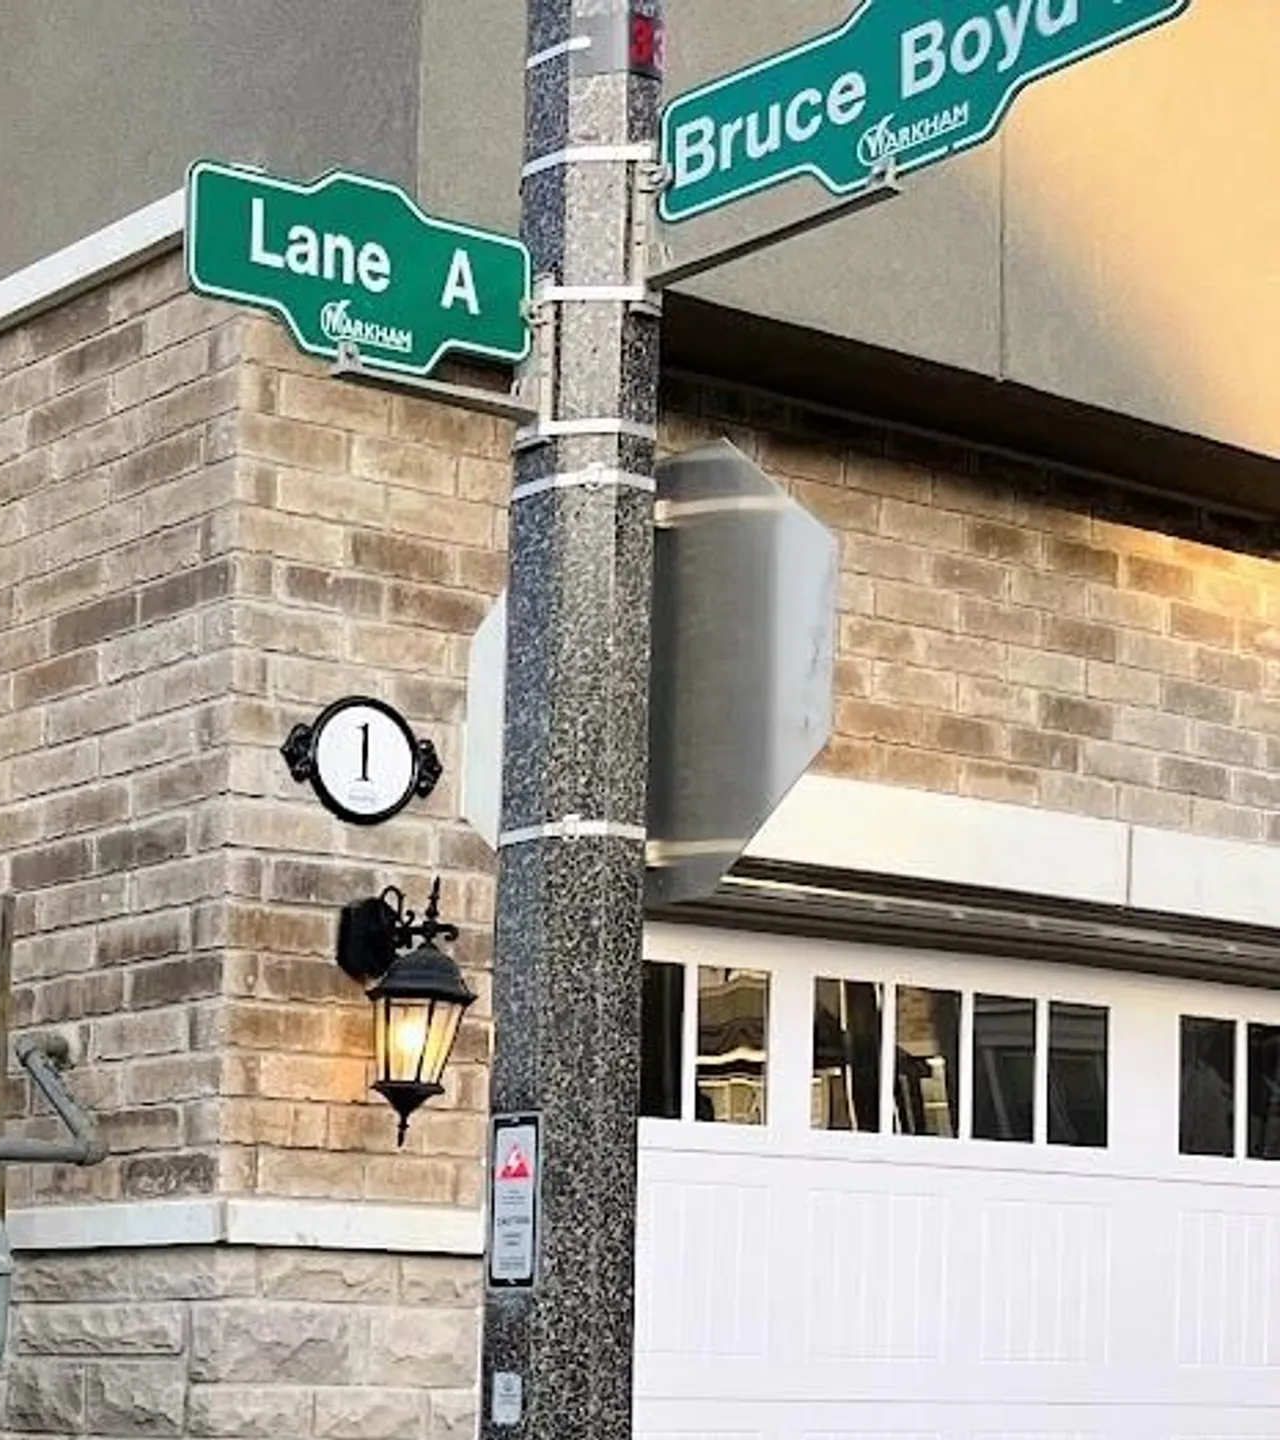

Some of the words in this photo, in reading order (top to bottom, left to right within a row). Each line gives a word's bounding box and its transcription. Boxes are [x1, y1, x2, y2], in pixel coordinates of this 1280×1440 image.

[674, 71, 867, 189] Bruce
[250, 198, 391, 294] Lane
[440, 248, 481, 316] A
[355, 722, 371, 782] 1
